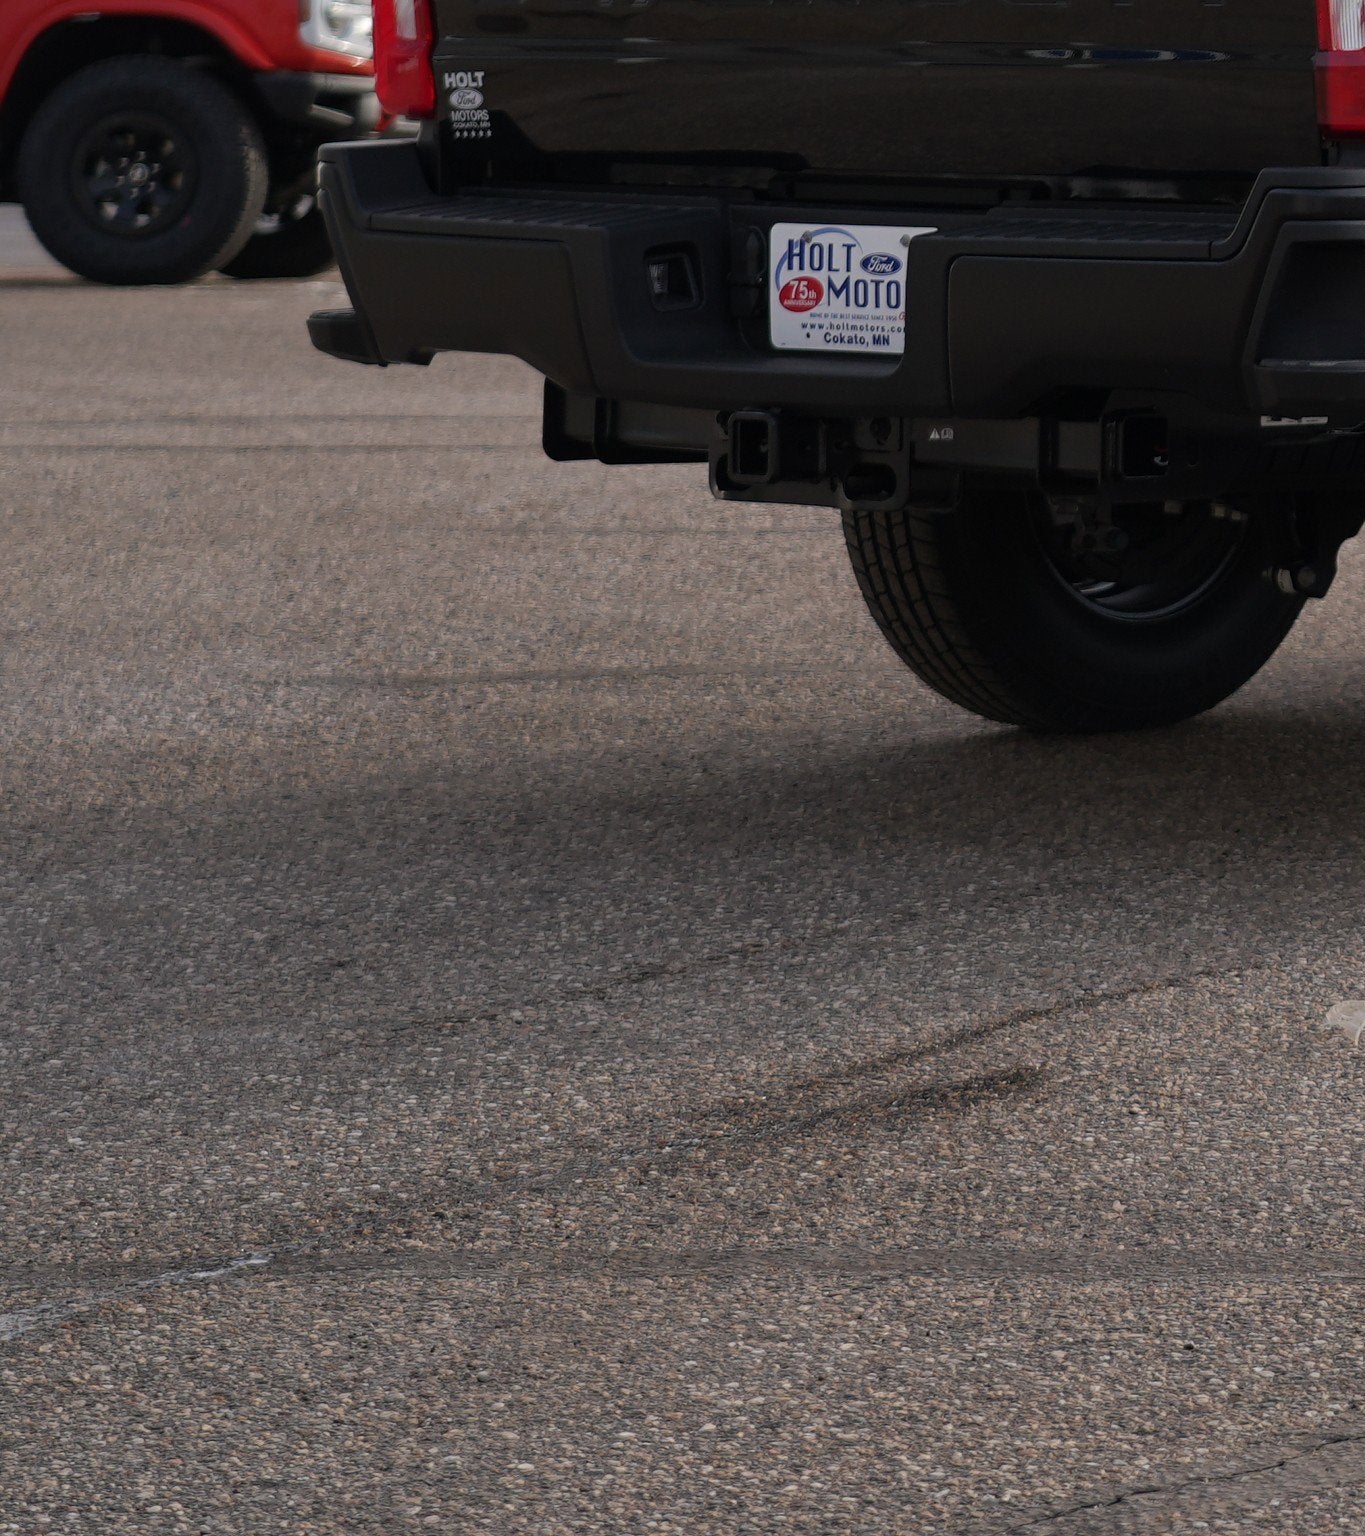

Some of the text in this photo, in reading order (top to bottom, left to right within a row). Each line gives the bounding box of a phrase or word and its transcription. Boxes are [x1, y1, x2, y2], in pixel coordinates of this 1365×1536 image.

[444, 71, 485, 89] HOLT
[451, 109, 490, 121] MOTORS
[787, 238, 857, 273] HOLT
[867, 255, 894, 272] Ford
[789, 280, 817, 300] 75th
[827, 274, 902, 310] MOTO
[823, 331, 891, 347] Cokato, MN
